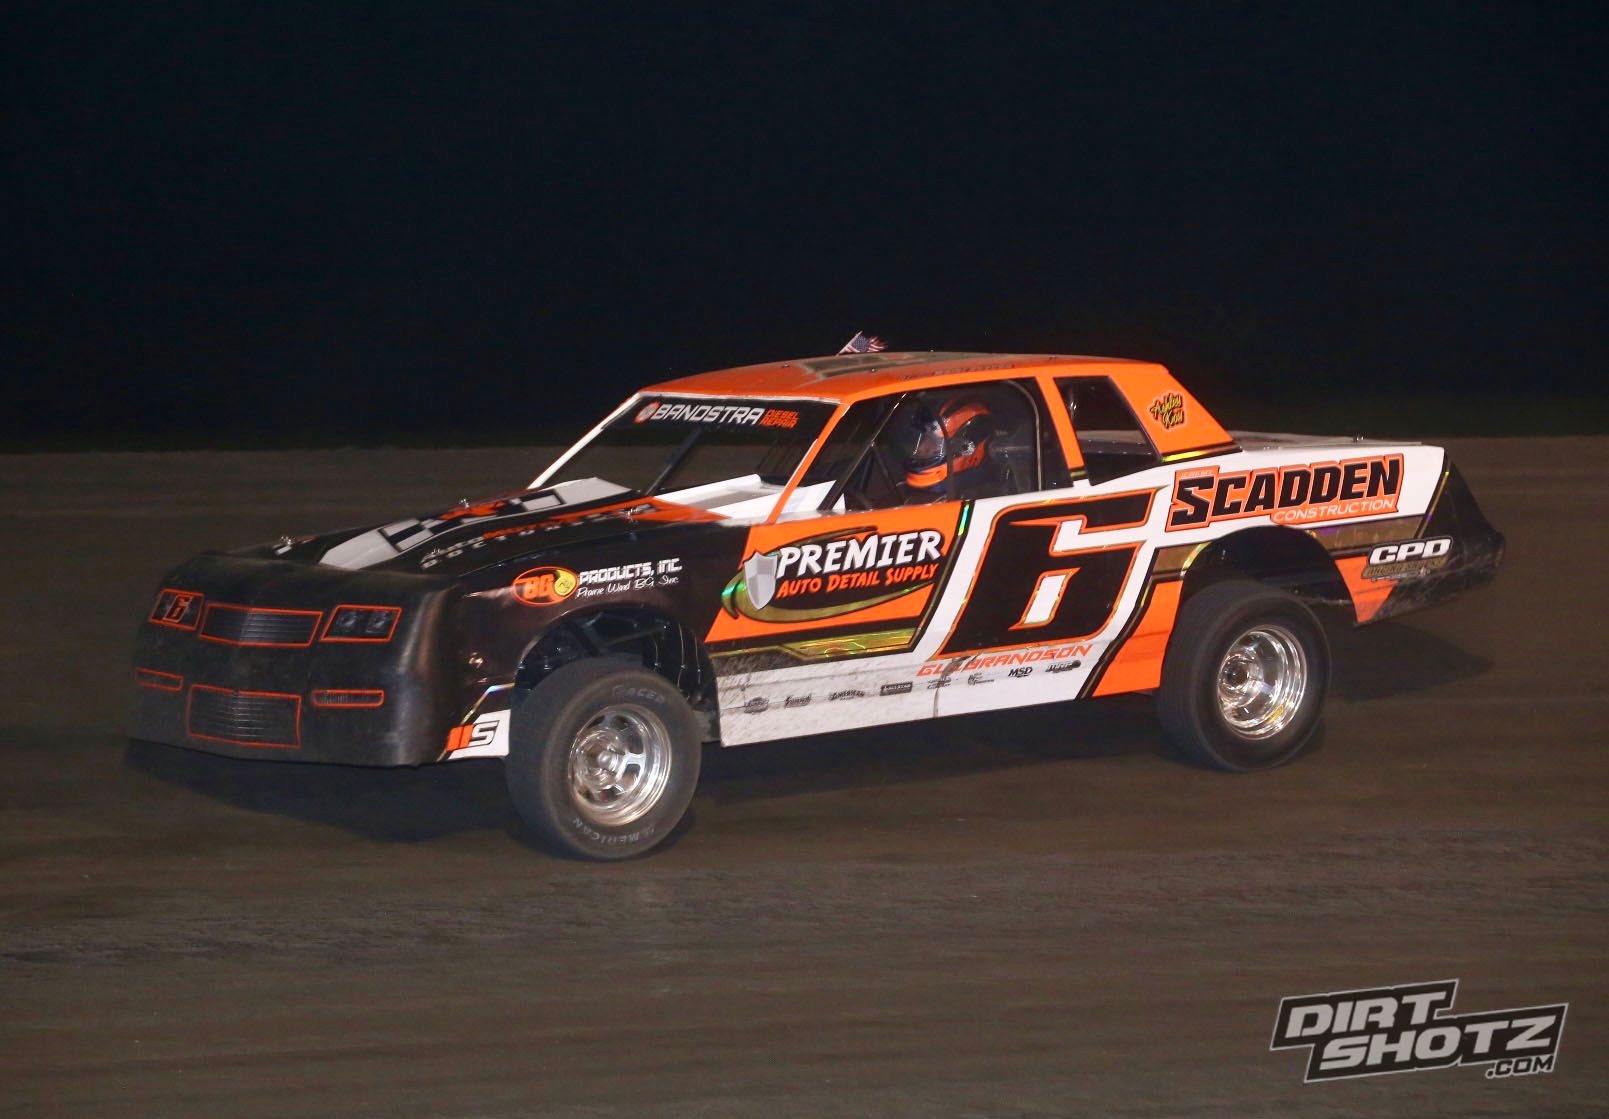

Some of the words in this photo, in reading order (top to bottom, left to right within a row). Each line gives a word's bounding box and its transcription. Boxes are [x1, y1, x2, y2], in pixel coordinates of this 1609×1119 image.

[650, 403, 766, 426] BANDSTRA
[1171, 457, 1399, 526] SCADDEN
[1274, 499, 1394, 523] CONSTRUCTION
[776, 530, 942, 579] PREMIER
[1369, 538, 1452, 566] CPD
[579, 562, 654, 585] PRODUCTS,
[607, 581, 631, 594] Wind
[634, 576, 655, 590] BG
[776, 578, 822, 599] AUTO
[826, 570, 880, 593] DETAIL
[885, 563, 939, 587] SUPPLY
[934, 488, 1157, 656] 6
[1008, 666, 1033, 678] MSD
